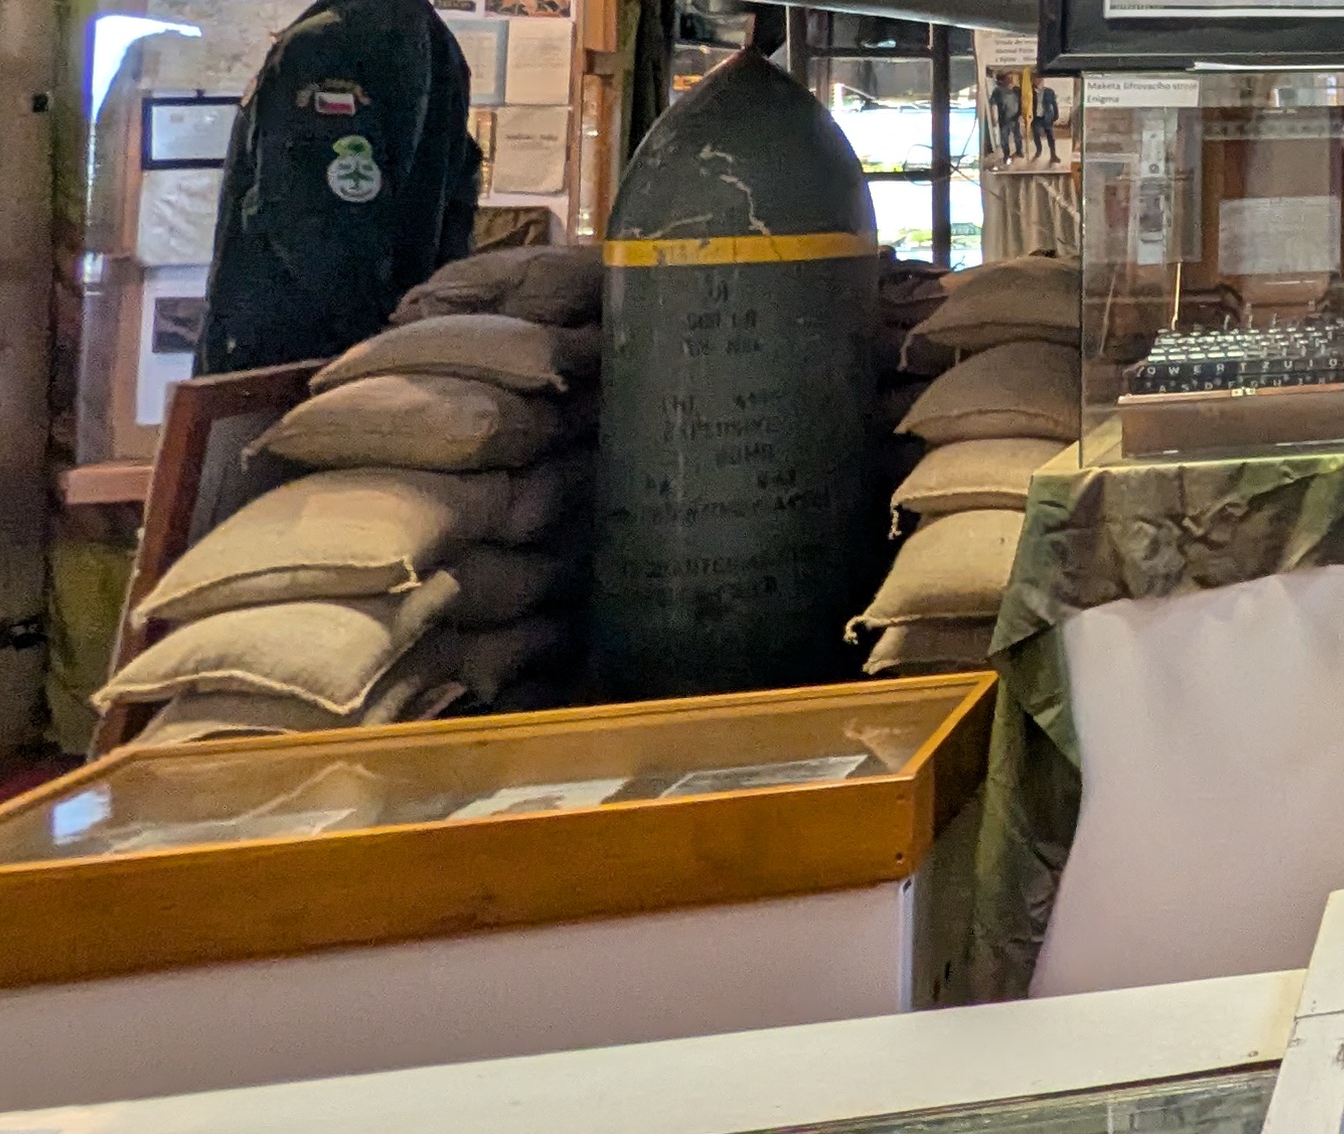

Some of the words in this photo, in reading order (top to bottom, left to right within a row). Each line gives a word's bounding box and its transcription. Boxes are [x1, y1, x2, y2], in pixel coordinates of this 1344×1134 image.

[1168, 365, 1179, 375] W
[1193, 365, 1200, 374] E
[1216, 363, 1225, 373] R
[1284, 361, 1292, 369] U
